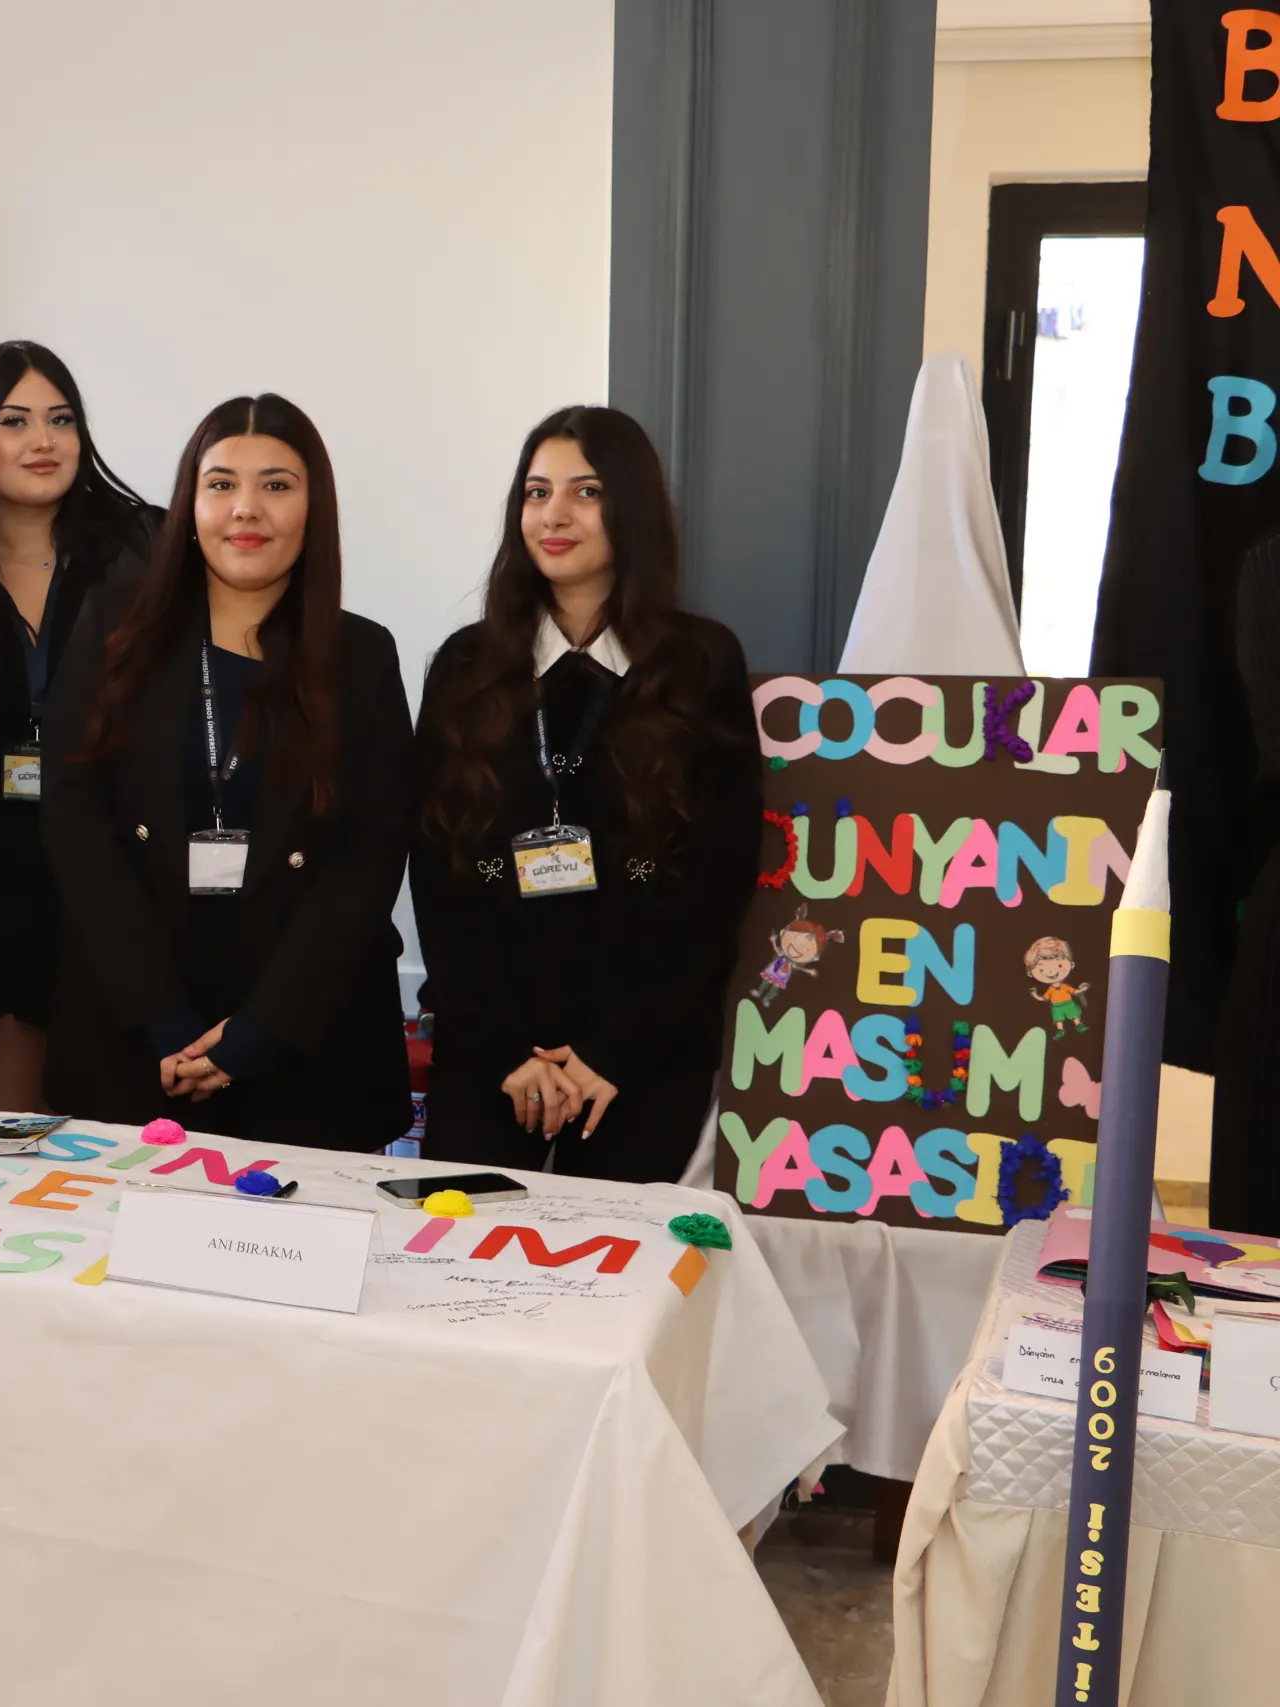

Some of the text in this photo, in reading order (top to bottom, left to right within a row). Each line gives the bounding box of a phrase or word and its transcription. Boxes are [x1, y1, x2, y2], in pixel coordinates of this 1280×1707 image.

[857, 917, 975, 1007] EN
[731, 999, 1047, 1122] MASUM
[207, 1237, 303, 1261] ANI BIRAKMA
